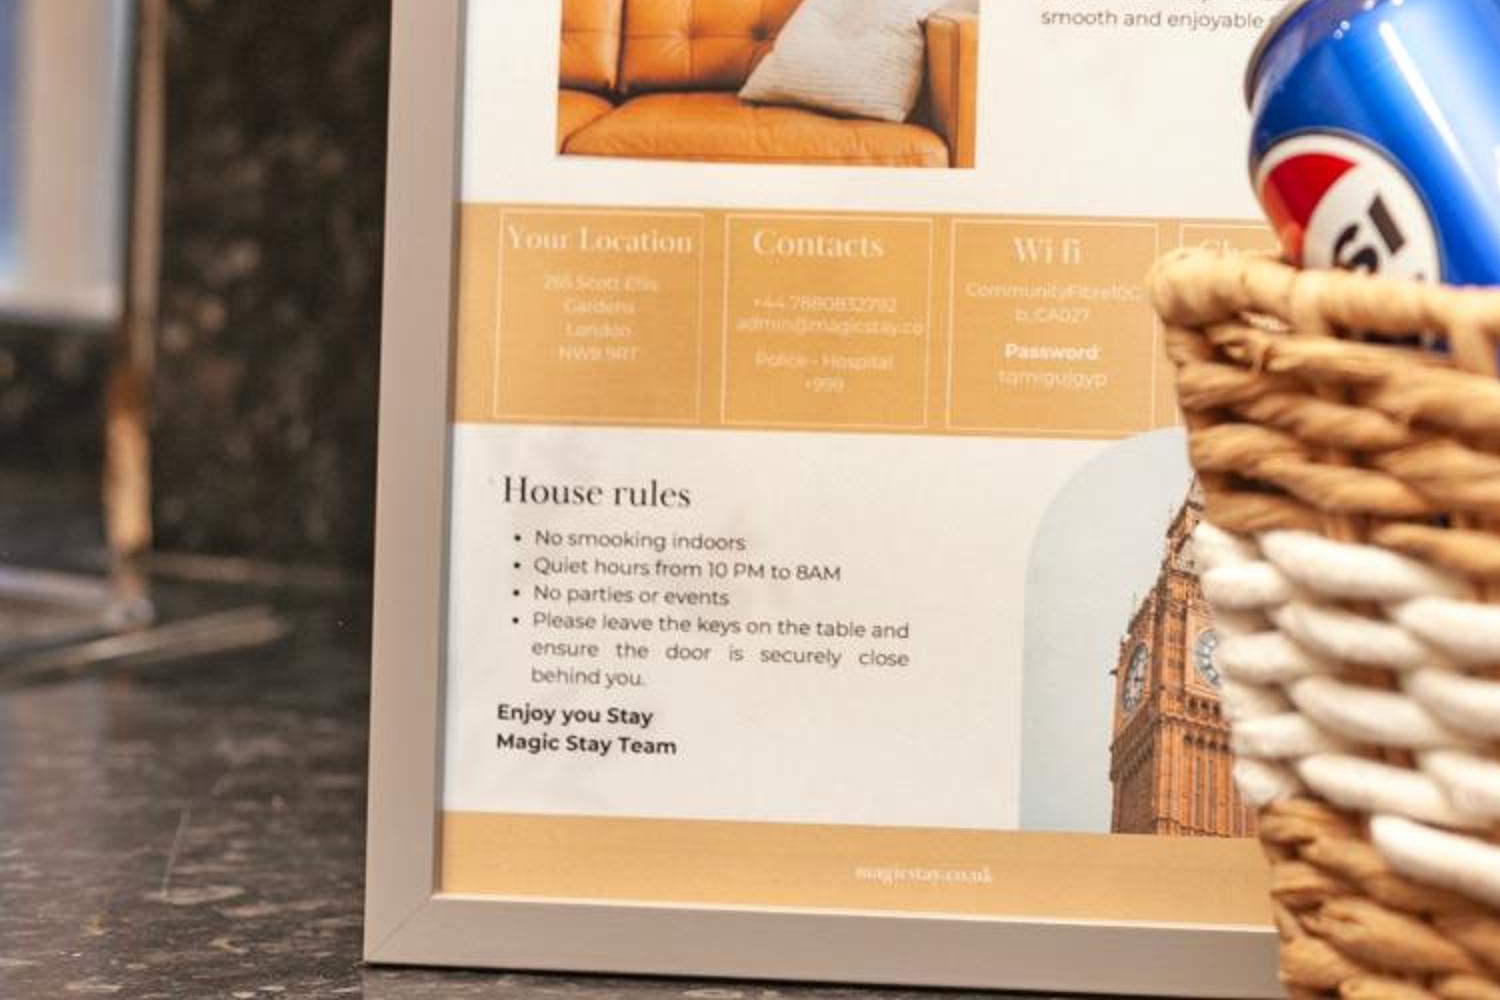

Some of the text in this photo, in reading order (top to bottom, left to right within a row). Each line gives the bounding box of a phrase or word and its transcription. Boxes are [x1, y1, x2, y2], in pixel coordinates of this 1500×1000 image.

[1041, 8, 1264, 31] smooth and enjoyable
[508, 224, 693, 253] Your Location
[752, 231, 885, 257] Contacts
[565, 322, 632, 338] London
[755, 351, 808, 368] Police
[821, 352, 895, 372] Hospital
[504, 475, 692, 507] House rules
[534, 530, 747, 552] No smooking indoors
[533, 556, 841, 581] Quiet hours from 10 PM to 8AM
[533, 584, 730, 606] No parties or events
[533, 611, 910, 639] Please leave the keys on the table and
[531, 642, 910, 668] ensure the door is securely close
[531, 667, 646, 689] behind you.
[497, 703, 653, 728] Enjoy you Stay
[496, 732, 678, 757] Magic Stay Team
